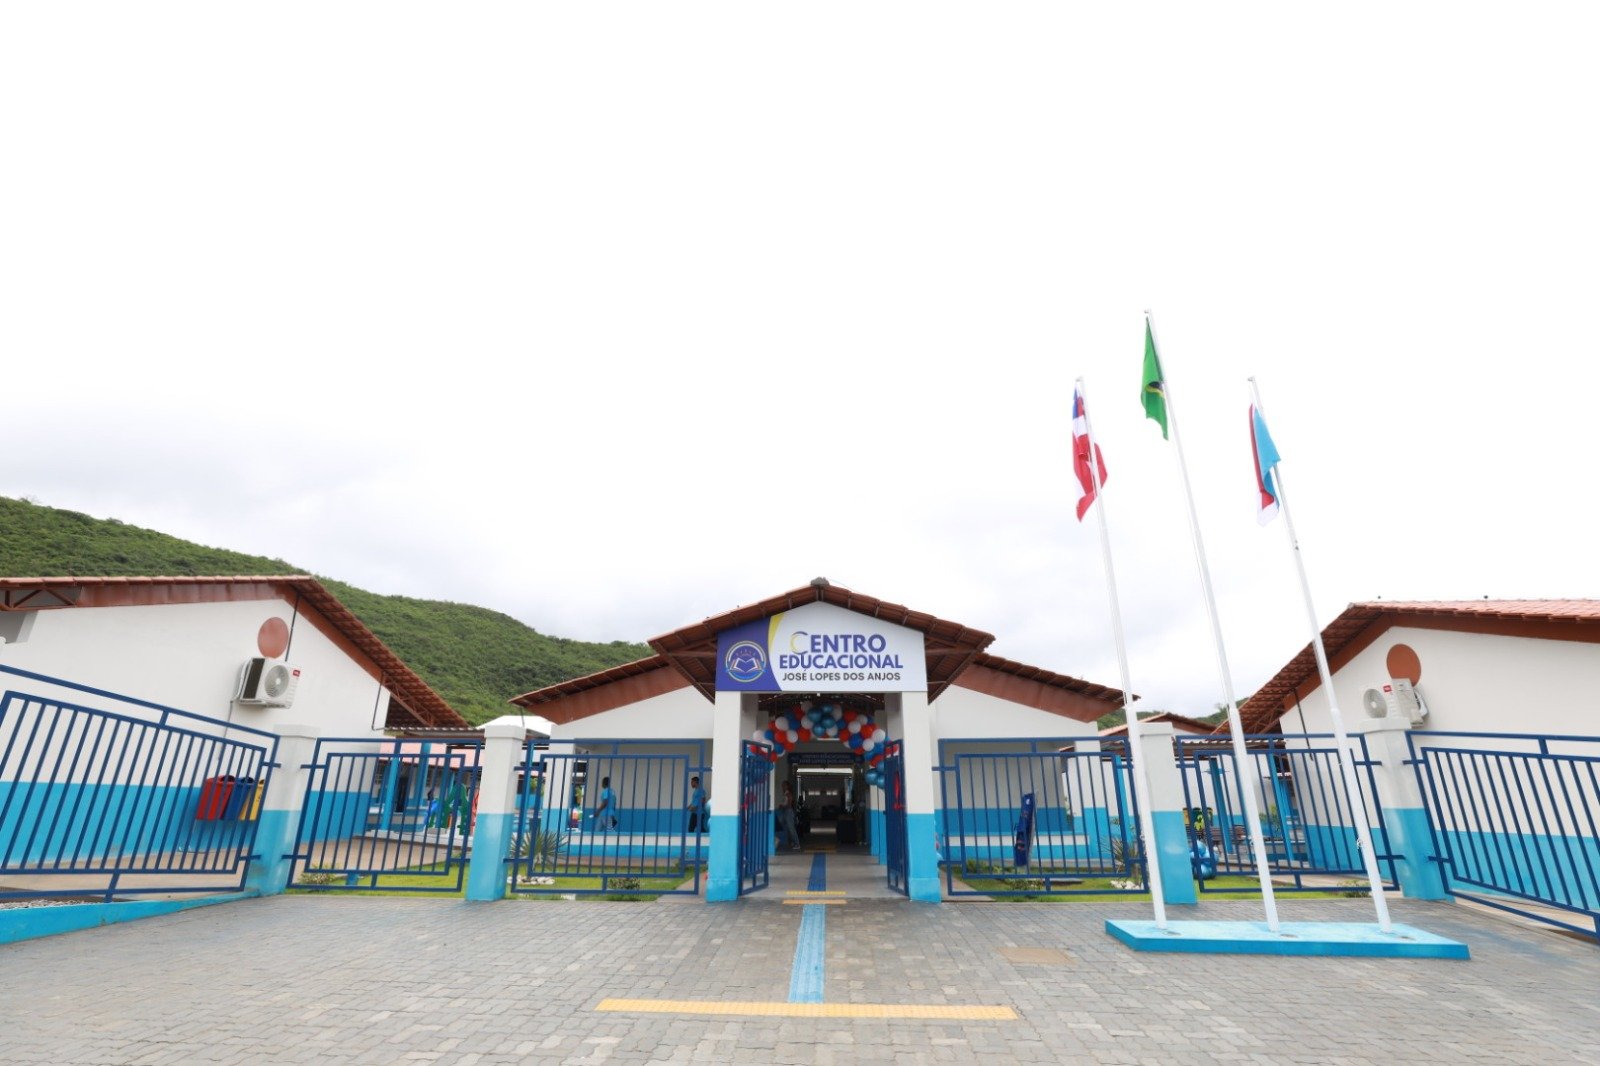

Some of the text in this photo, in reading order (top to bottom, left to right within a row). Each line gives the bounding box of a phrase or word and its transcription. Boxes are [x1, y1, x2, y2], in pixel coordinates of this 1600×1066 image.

[790, 631, 887, 654] CENTRO
[779, 654, 903, 669] EDUCACIONAL
[782, 669, 901, 681] JOSÉ LOPES DOS ANJOS
